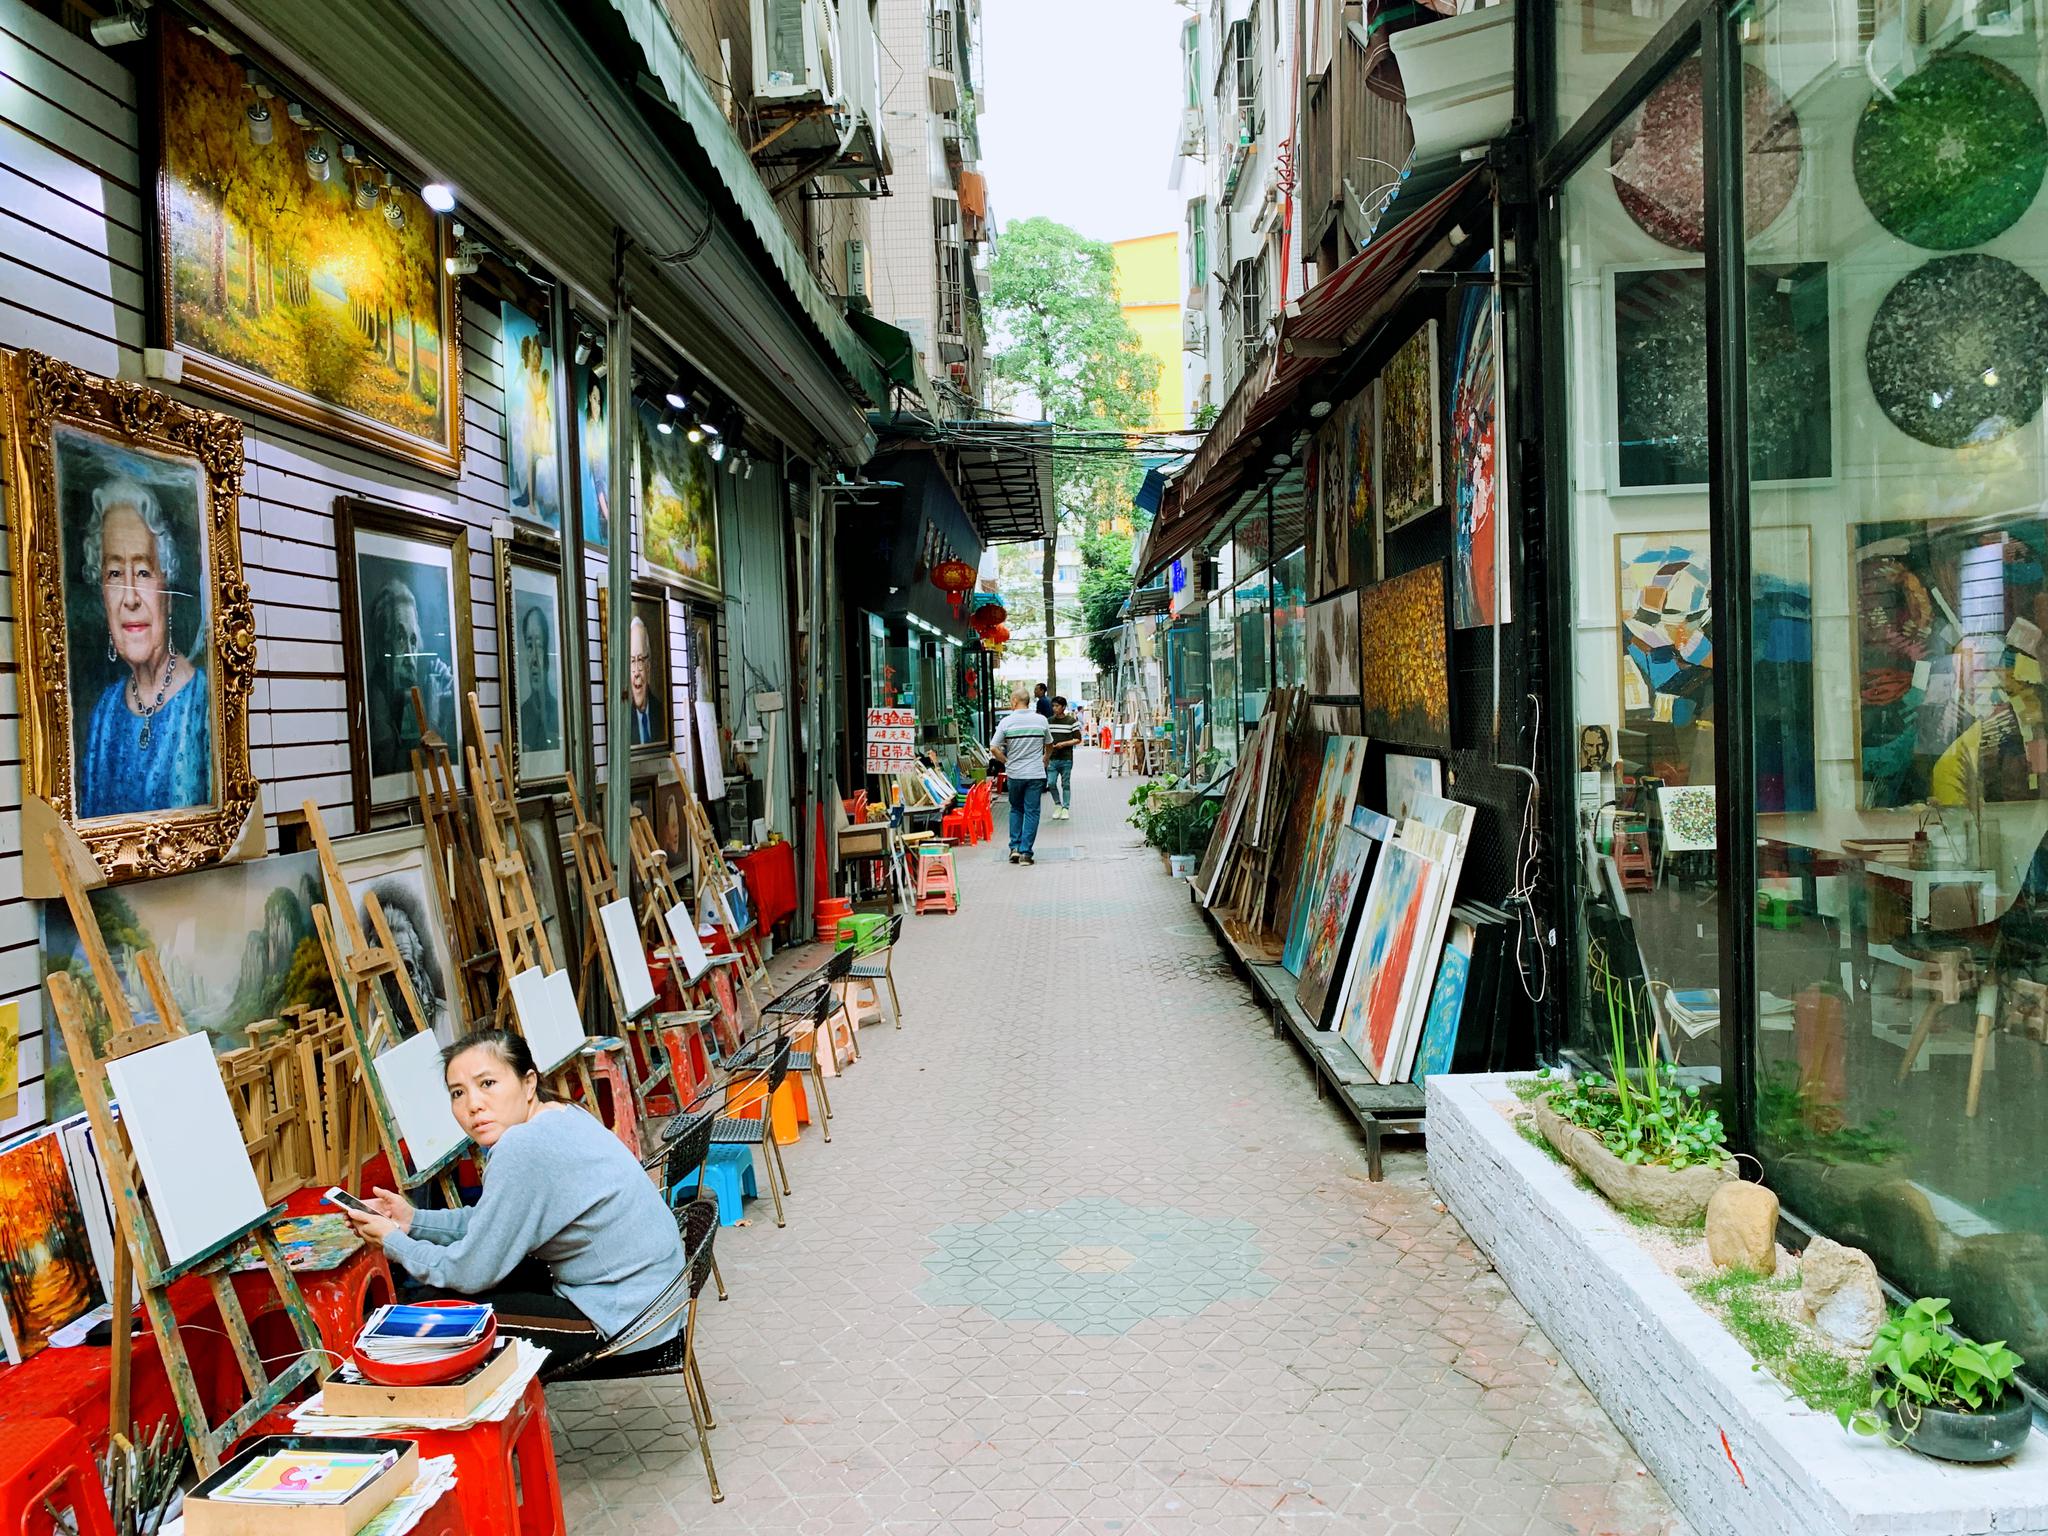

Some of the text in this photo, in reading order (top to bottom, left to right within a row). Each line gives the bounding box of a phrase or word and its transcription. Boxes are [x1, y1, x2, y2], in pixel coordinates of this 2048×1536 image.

[868, 710, 914, 726] 体验画
[870, 743, 914, 758] 自己带走
